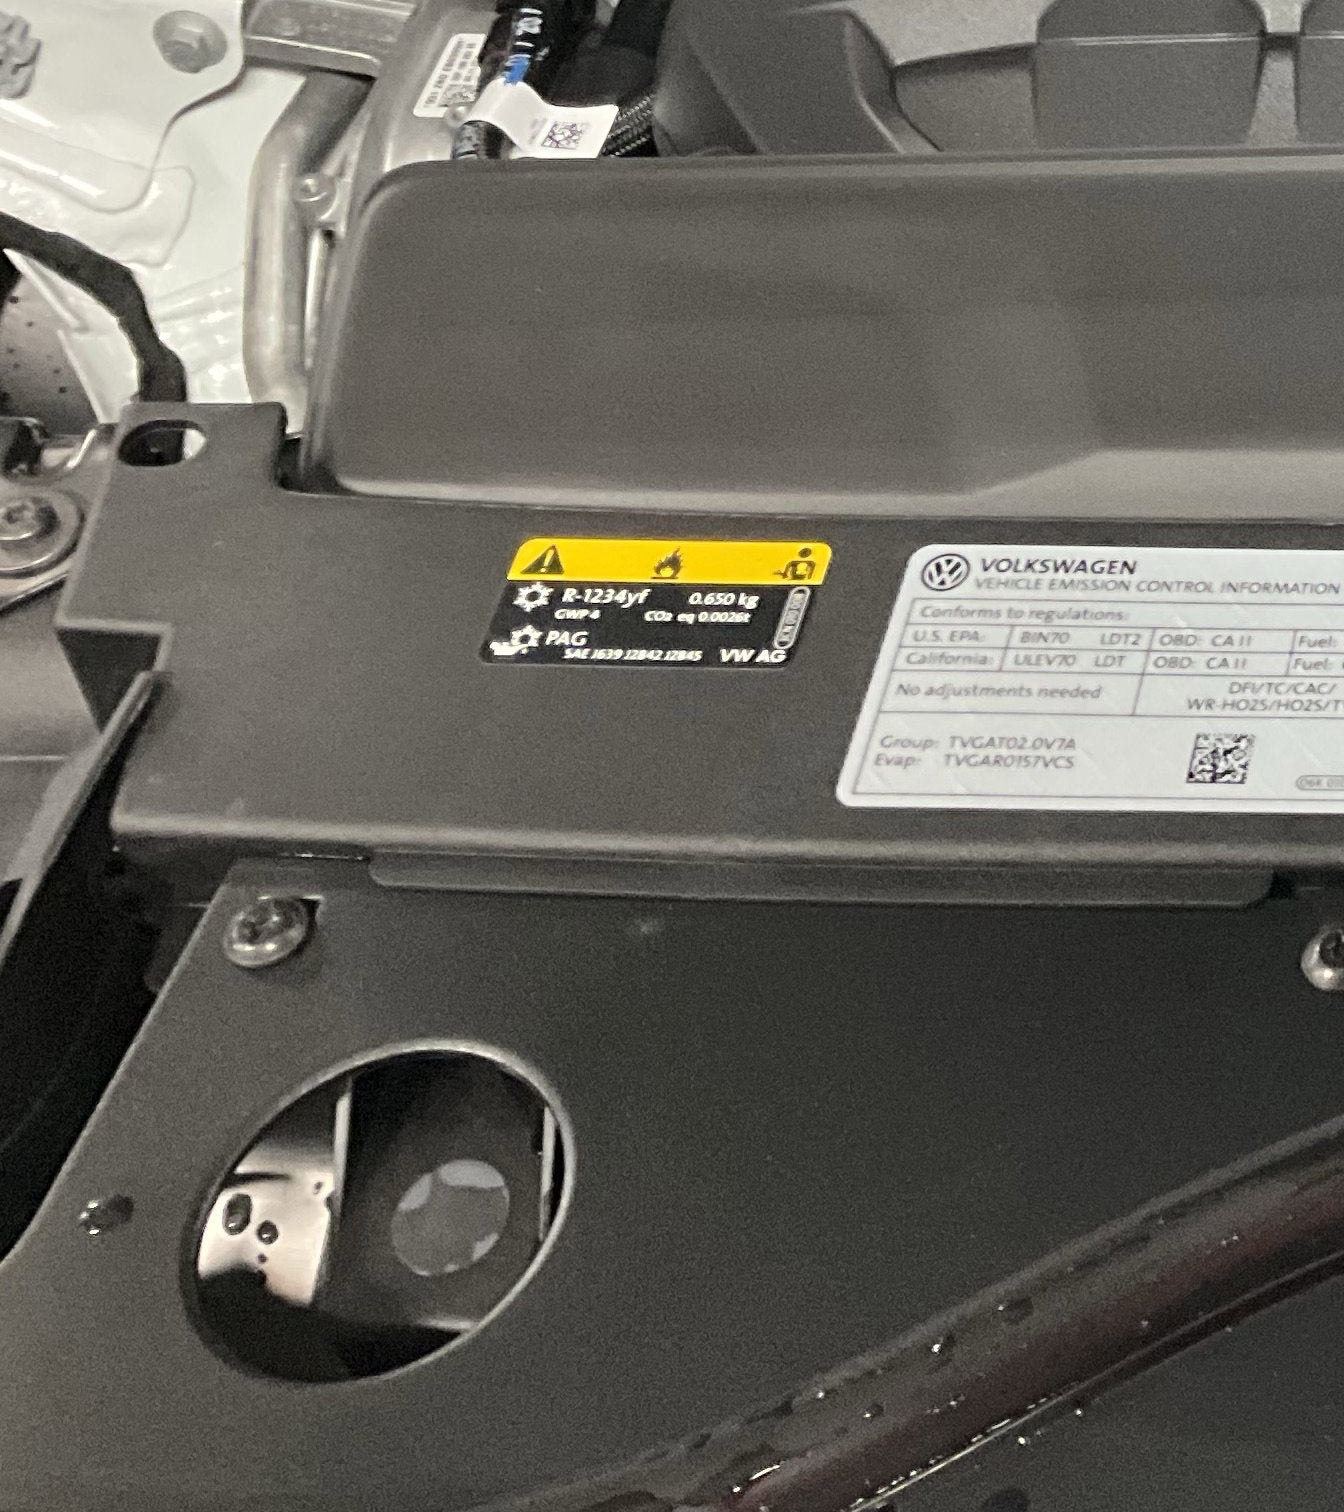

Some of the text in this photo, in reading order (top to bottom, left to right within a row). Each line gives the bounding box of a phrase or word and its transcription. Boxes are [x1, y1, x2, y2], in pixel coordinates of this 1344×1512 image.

[980, 558, 1138, 575] VOLKSWAGEN
[973, 576, 1342, 595] VEHICLE EMISSION CONTROL INFORMATION
[561, 588, 652, 609] R-1234yf
[688, 592, 760, 610] 0.650 kg
[554, 609, 601, 620] GWP 4
[677, 613, 695, 624] eq
[920, 605, 1129, 623] Conforms to regulations:
[545, 631, 589, 646] PAG
[914, 630, 942, 642] U.S.
[1021, 631, 1071, 644] BIN70
[1100, 632, 1142, 646] LDT2
[1211, 635, 1234, 648] CA
[1298, 635, 1337, 649] Fuel:
[563, 648, 590, 660] SAE
[720, 648, 787, 663] VW AG
[906, 652, 994, 666] California:
[1014, 654, 1077, 667] ULEV70
[1094, 655, 1127, 667] LDT
[1205, 657, 1230, 670] CA
[1293, 658, 1332, 671] Fuel:
[896, 683, 1102, 700] No adjustments needed
[1228, 681, 1337, 695] DFI/TC/CAC/
[880, 734, 939, 751] Group:
[874, 753, 921, 769] Evap:
